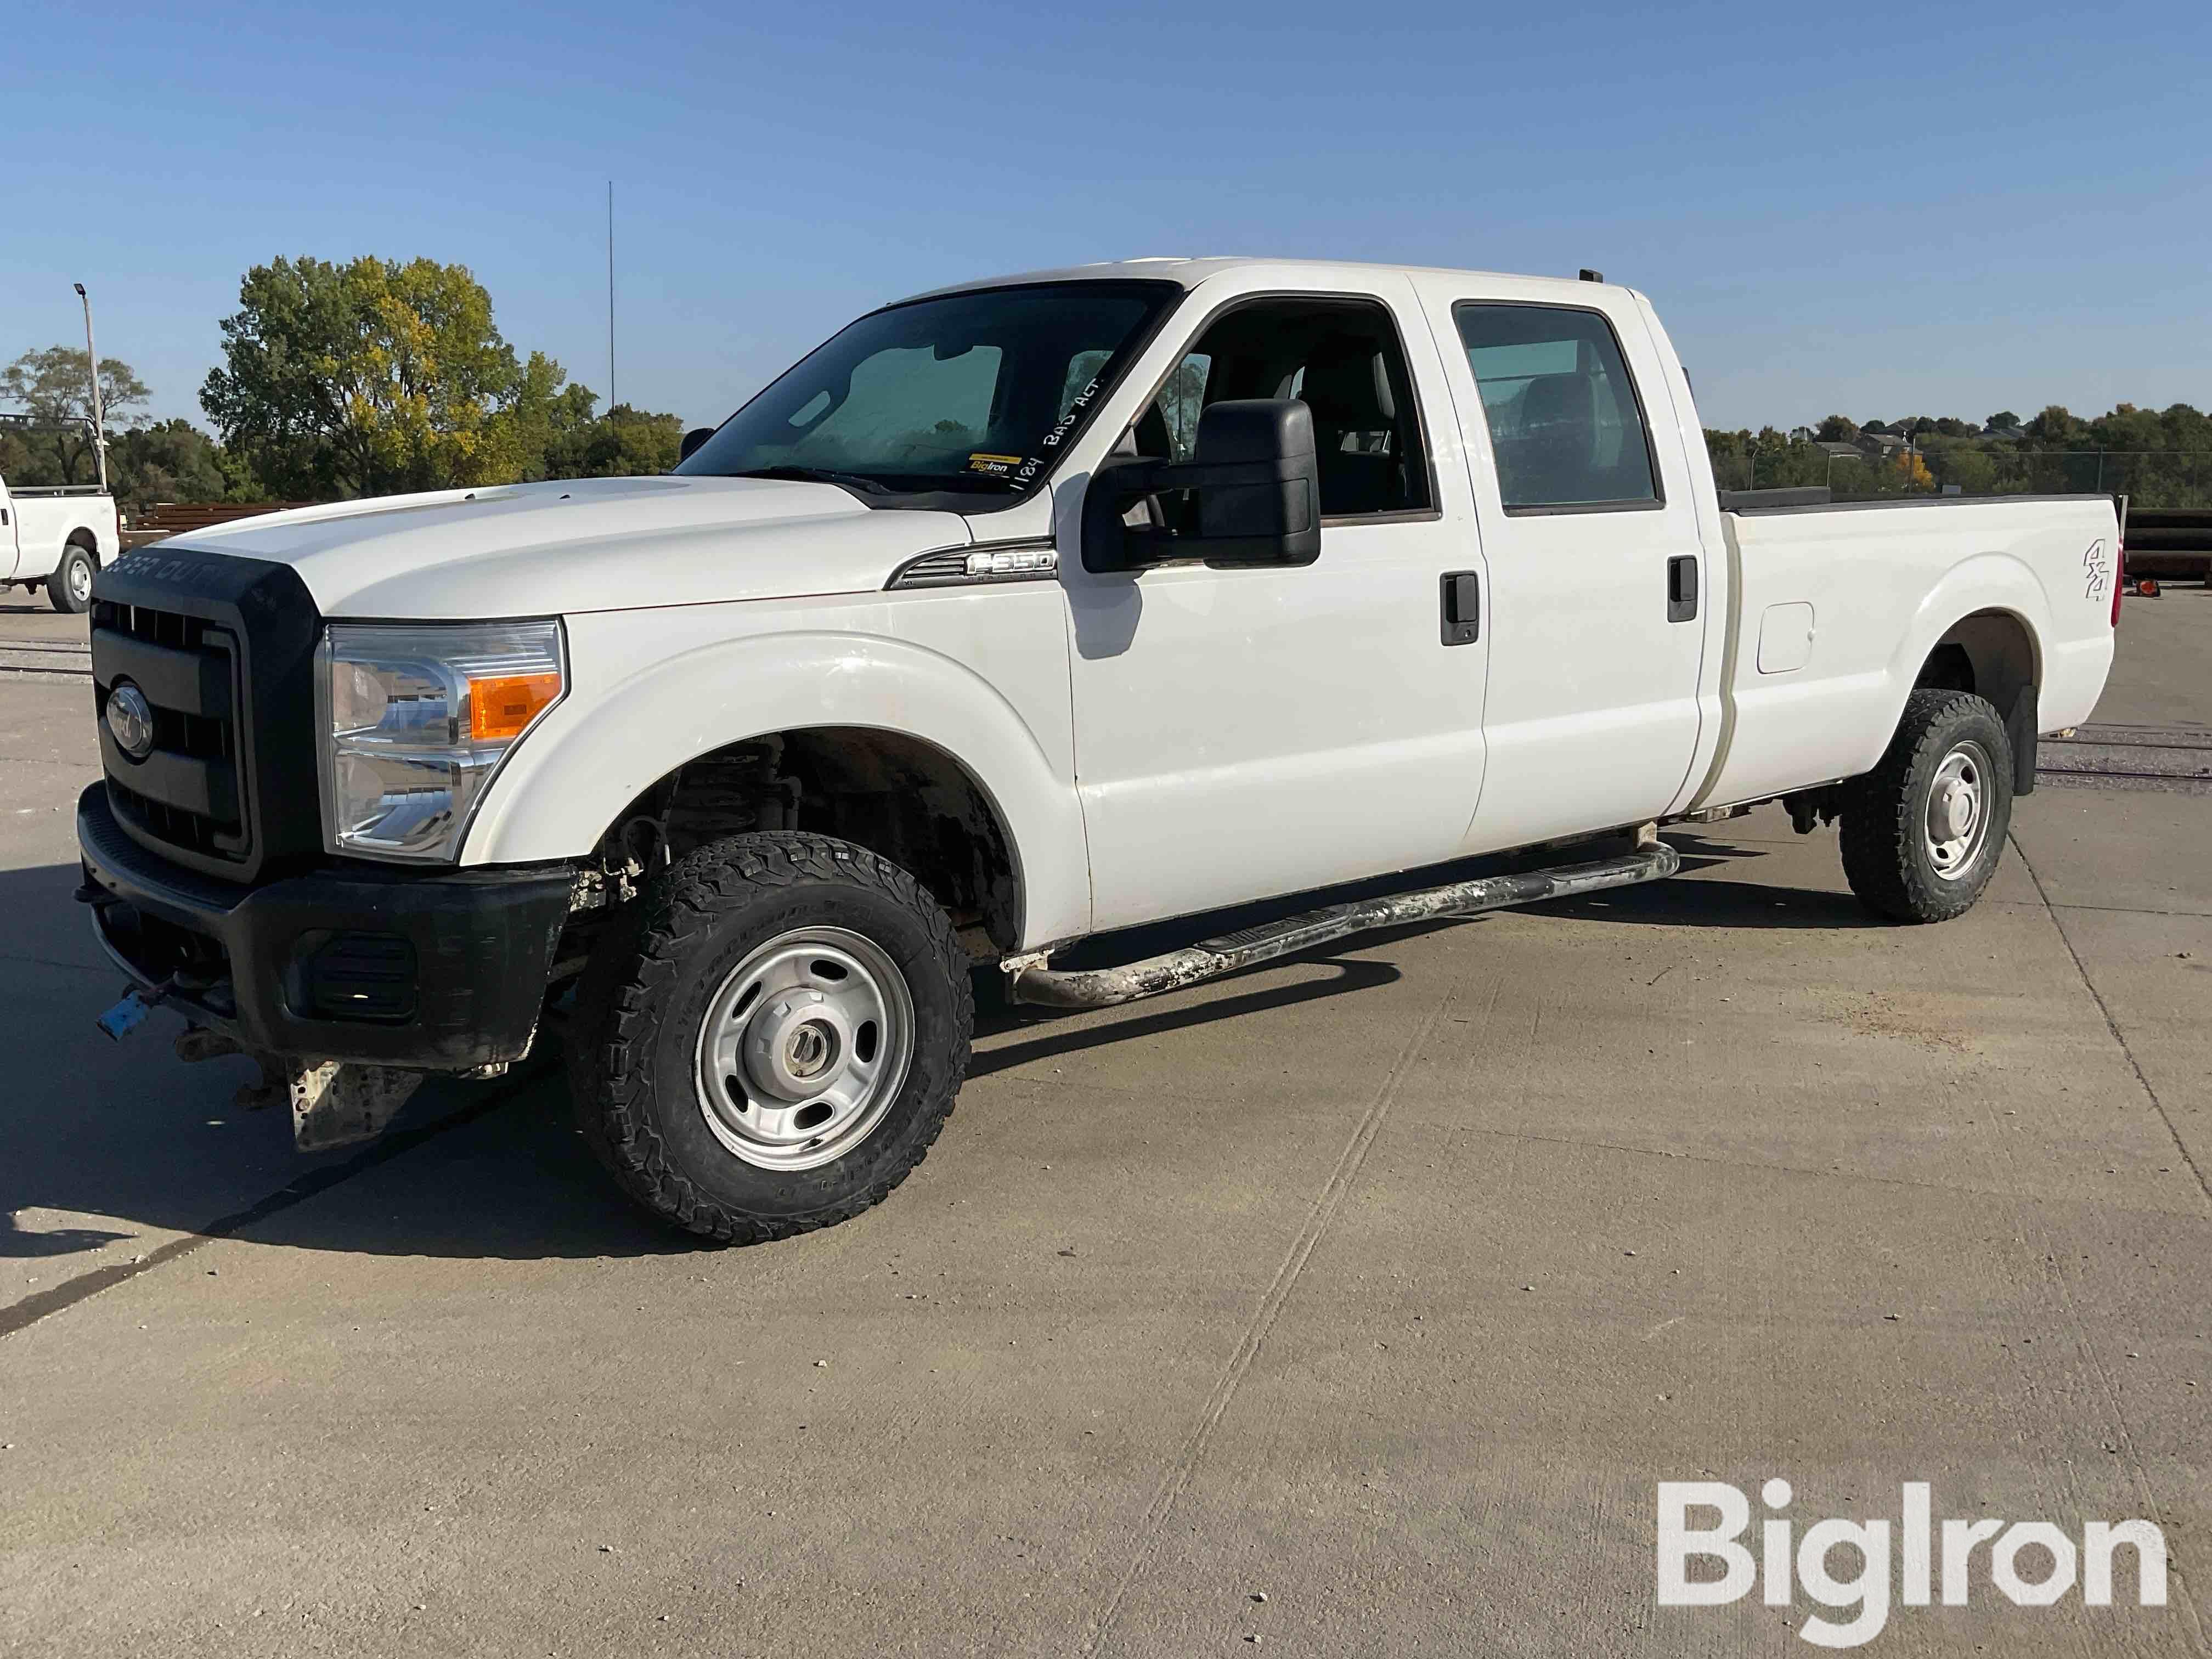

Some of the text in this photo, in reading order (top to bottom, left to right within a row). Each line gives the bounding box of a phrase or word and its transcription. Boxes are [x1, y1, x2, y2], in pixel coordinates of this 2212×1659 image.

[969, 460, 1008, 472] BigIron
[1010, 457, 1045, 490] 1184
[1043, 414, 1076, 446] BAD
